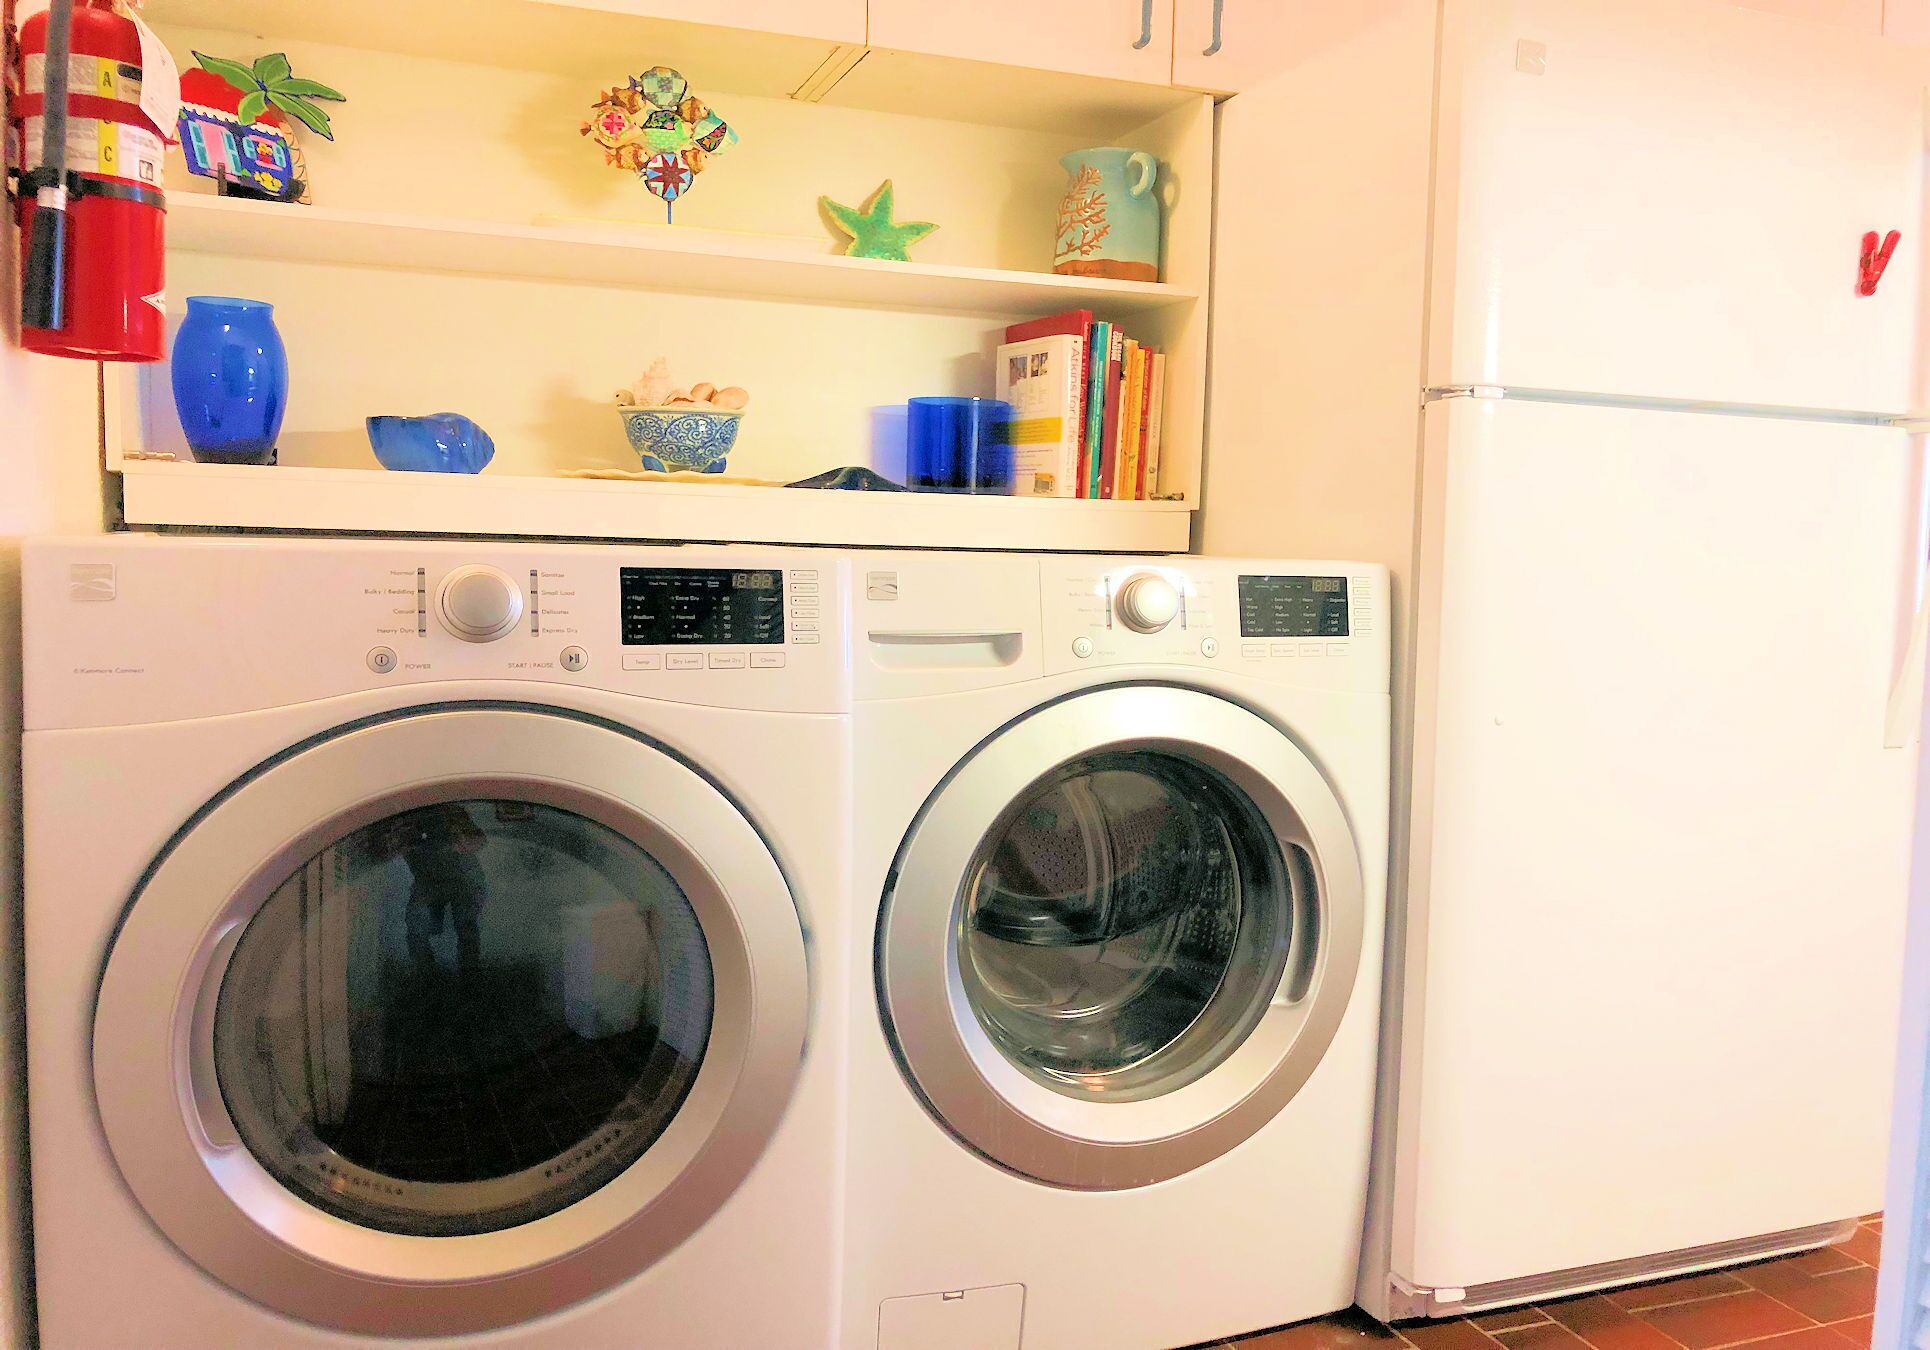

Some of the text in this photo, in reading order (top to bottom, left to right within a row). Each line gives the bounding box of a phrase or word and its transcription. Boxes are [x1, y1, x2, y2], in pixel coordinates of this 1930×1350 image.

[102, 71, 112, 88] A
[103, 145, 112, 162] C
[1070, 347, 1080, 392] Atkins
[1069, 395, 1079, 414] for
[388, 588, 415, 597] Bedding
[541, 589, 559, 597] Small
[376, 627, 415, 636] Heavy Duty
[541, 627, 578, 635] Express Dry
[507, 661, 528, 669] START
[532, 661, 554, 669] PAUSE
[634, 658, 651, 666] Temp
[672, 658, 683, 666] Dry
[731, 657, 741, 665] Dry
[404, 662, 432, 670] POWER
